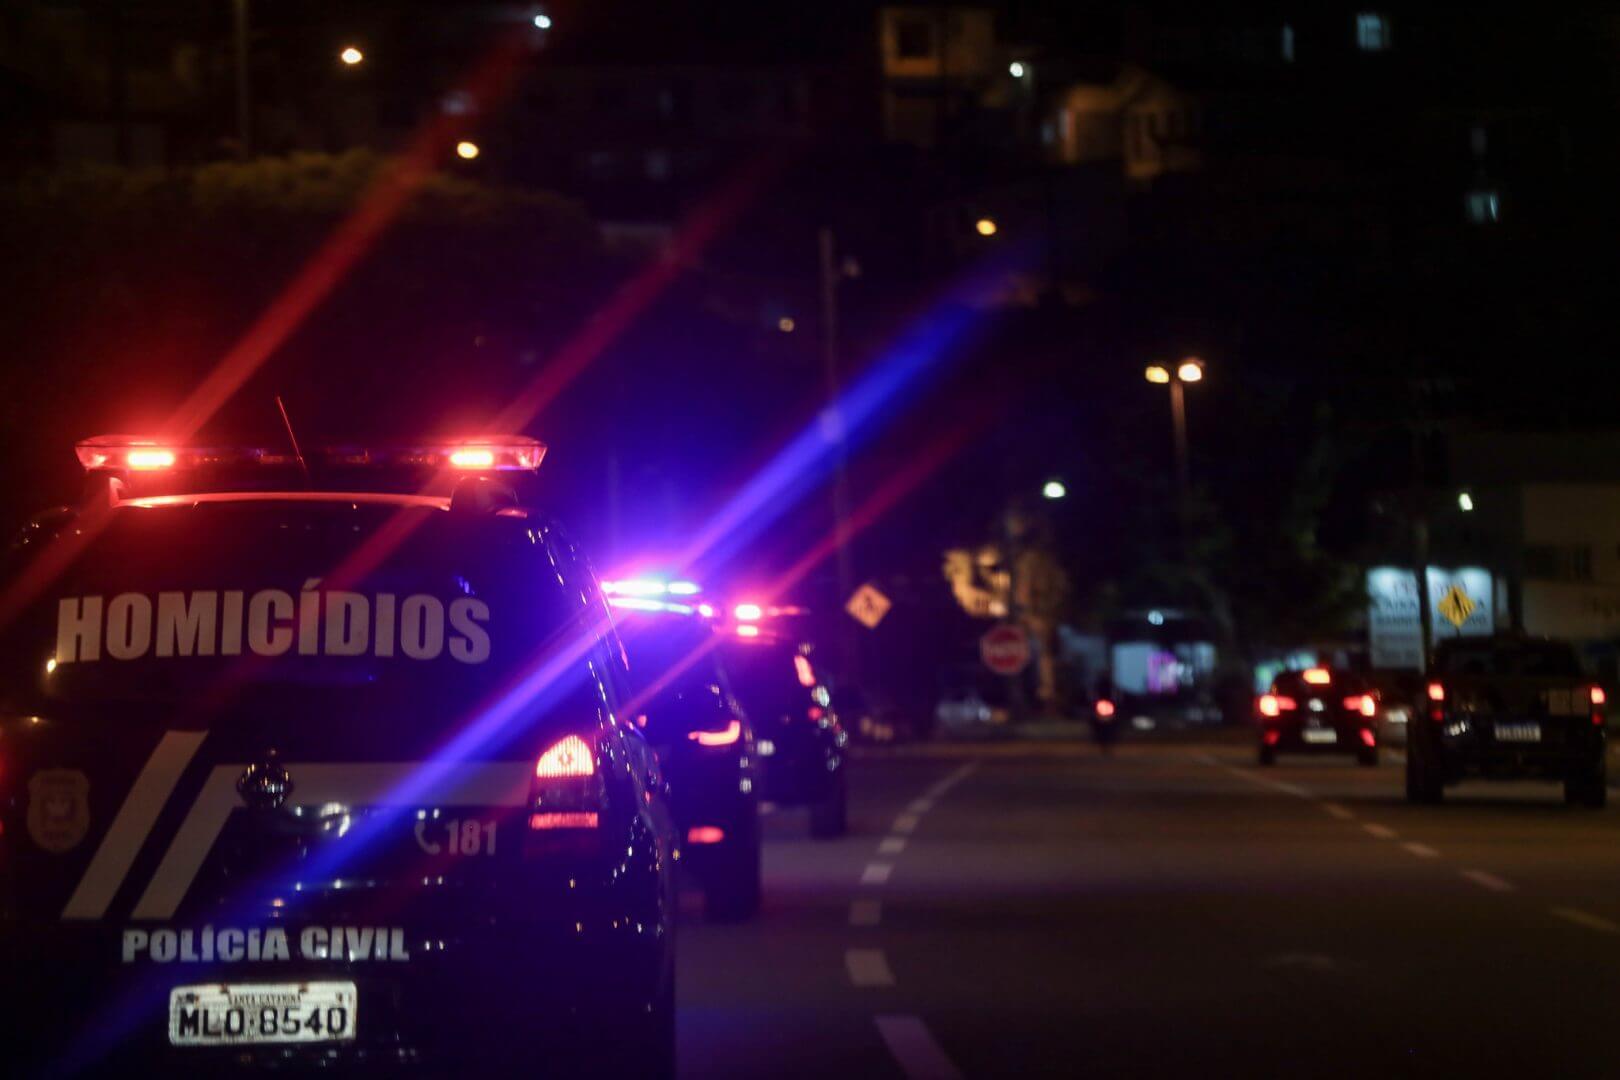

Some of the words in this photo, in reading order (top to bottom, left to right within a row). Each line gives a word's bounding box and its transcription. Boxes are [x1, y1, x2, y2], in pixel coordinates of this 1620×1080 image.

[57, 577, 491, 664] HOMICÍDIOS
[445, 818, 497, 856] 181
[121, 923, 290, 963] POLÍCIA
[301, 926, 411, 962] CIVIL
